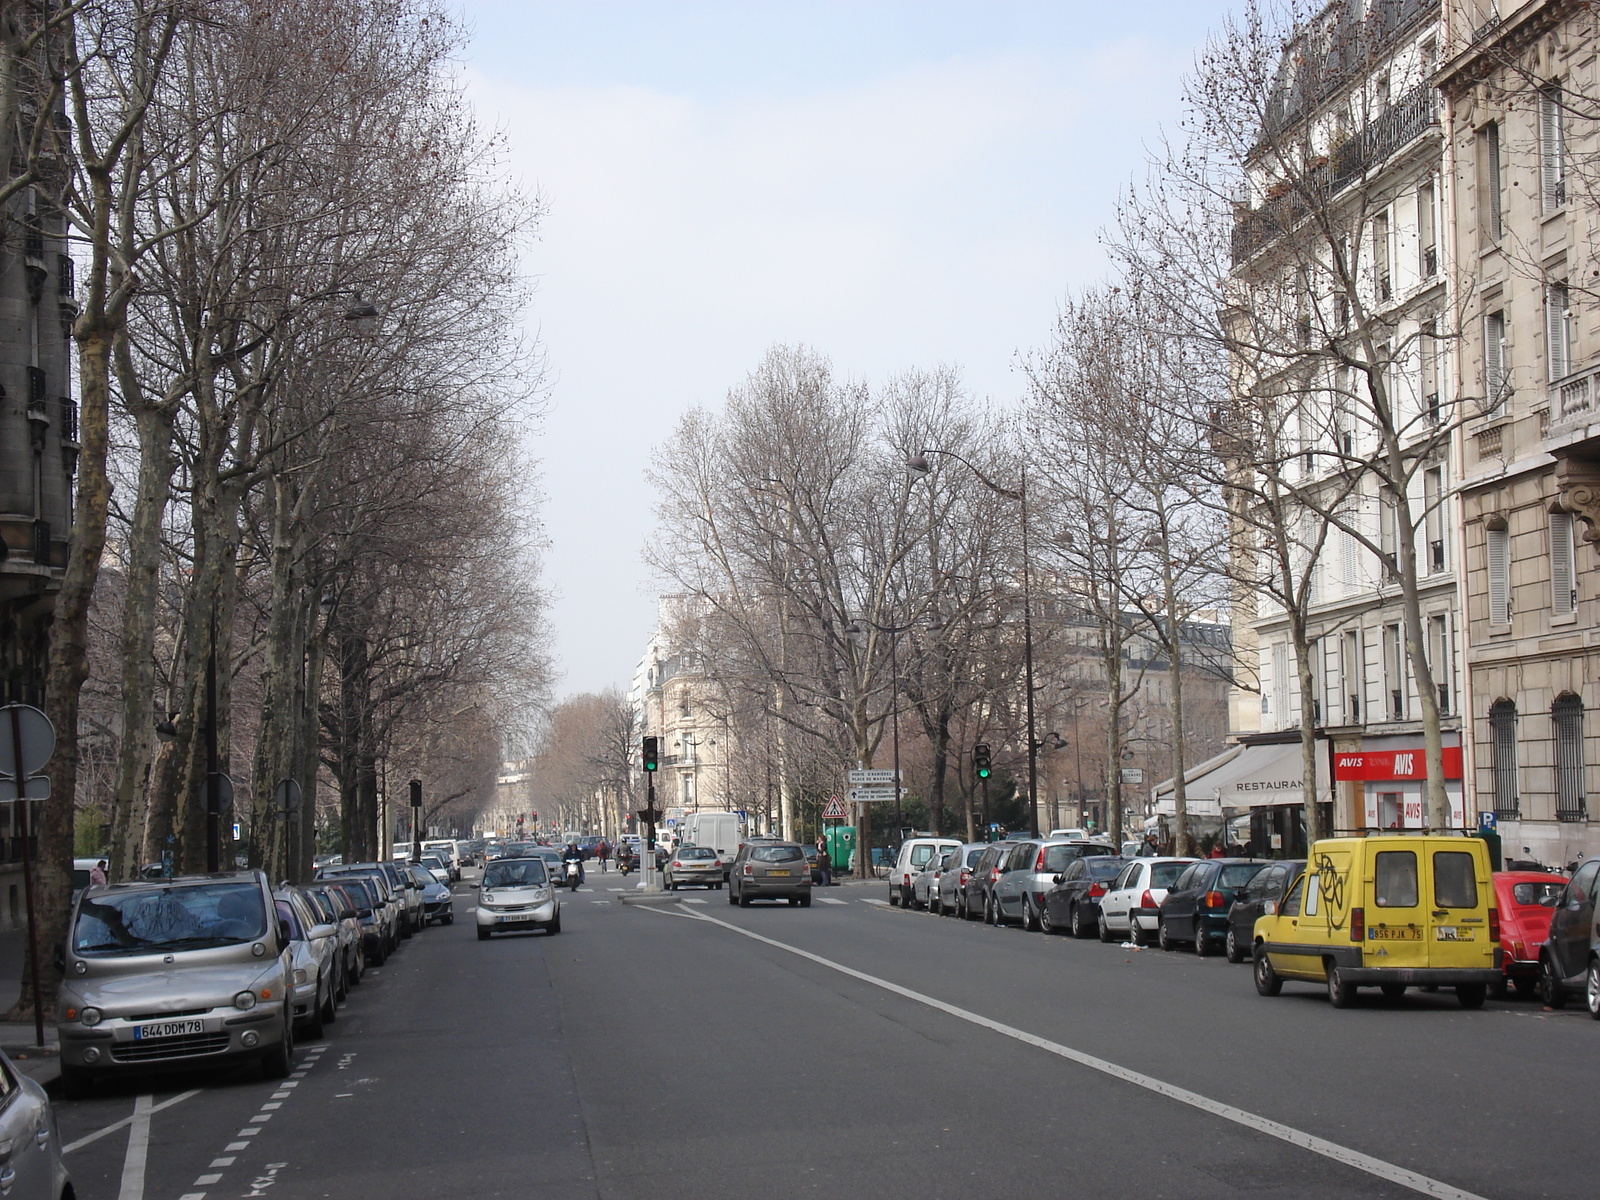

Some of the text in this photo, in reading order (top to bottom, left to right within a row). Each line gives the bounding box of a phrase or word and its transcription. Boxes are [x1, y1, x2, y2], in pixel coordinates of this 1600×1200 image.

[1338, 757, 1364, 767] AVIS
[1393, 753, 1414, 776] AVIS
[1236, 780, 1305, 792] RESTAURAN
[1367, 810, 1376, 818] AVIS
[1405, 803, 1421, 819] AVIS
[1453, 811, 1462, 819] AVIS
[1374, 929, 1421, 939] 856 PJK 75
[141, 1021, 201, 1038] 644 DDM 78
